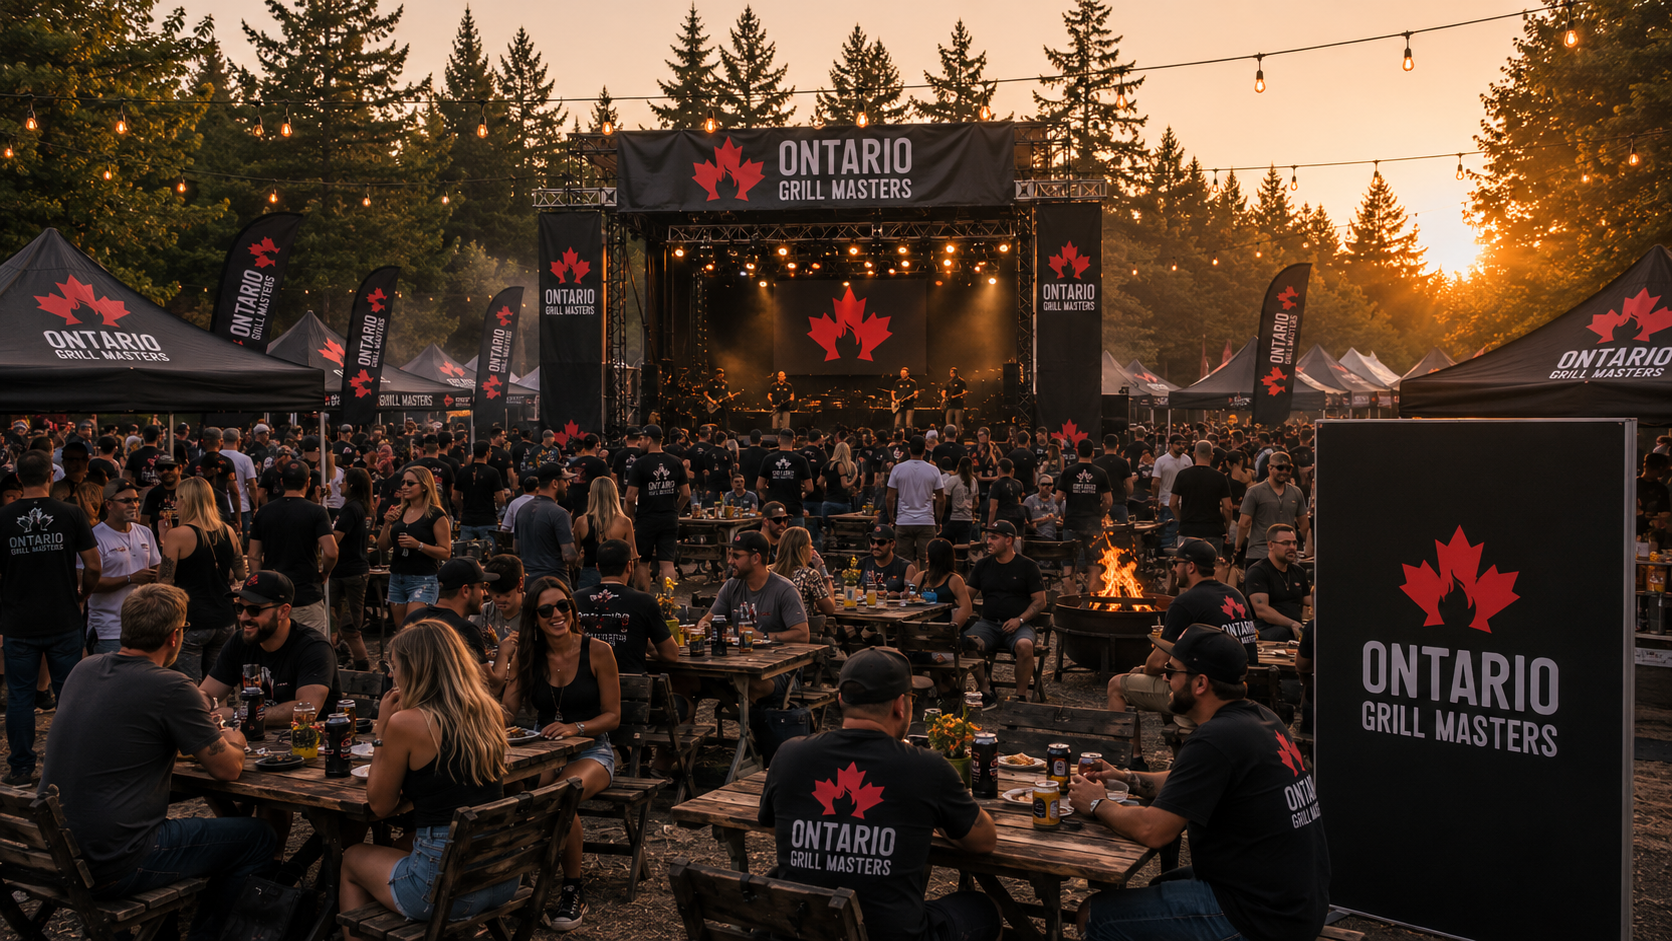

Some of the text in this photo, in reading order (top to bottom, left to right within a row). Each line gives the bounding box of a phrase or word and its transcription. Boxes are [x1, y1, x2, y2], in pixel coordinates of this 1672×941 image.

[779, 138, 912, 176] ONTARIO
[779, 178, 912, 201] GRILL MASTERS
[230, 269, 263, 338] ONTARIO
[546, 288, 594, 304] ONTARIO
[1043, 284, 1095, 300] ONTARIO
[43, 330, 162, 352] ONTARIO
[358, 314, 378, 366] ONTARIO
[488, 328, 505, 372] ONTARIO
[1270, 312, 1289, 364] ONTARIO
[55, 349, 170, 362] GRILL MASTERS
[1557, 346, 1672, 369] ONTARIO
[1549, 368, 1665, 379] GRILL MASTERS
[9, 532, 64, 548] ONTARIO
[1362, 640, 1559, 716] ONTARIO
[1362, 700, 1558, 758] GRILL MASTERS
[791, 819, 896, 857] ONTARIO
[791, 850, 892, 876] GRILL MASTERS
